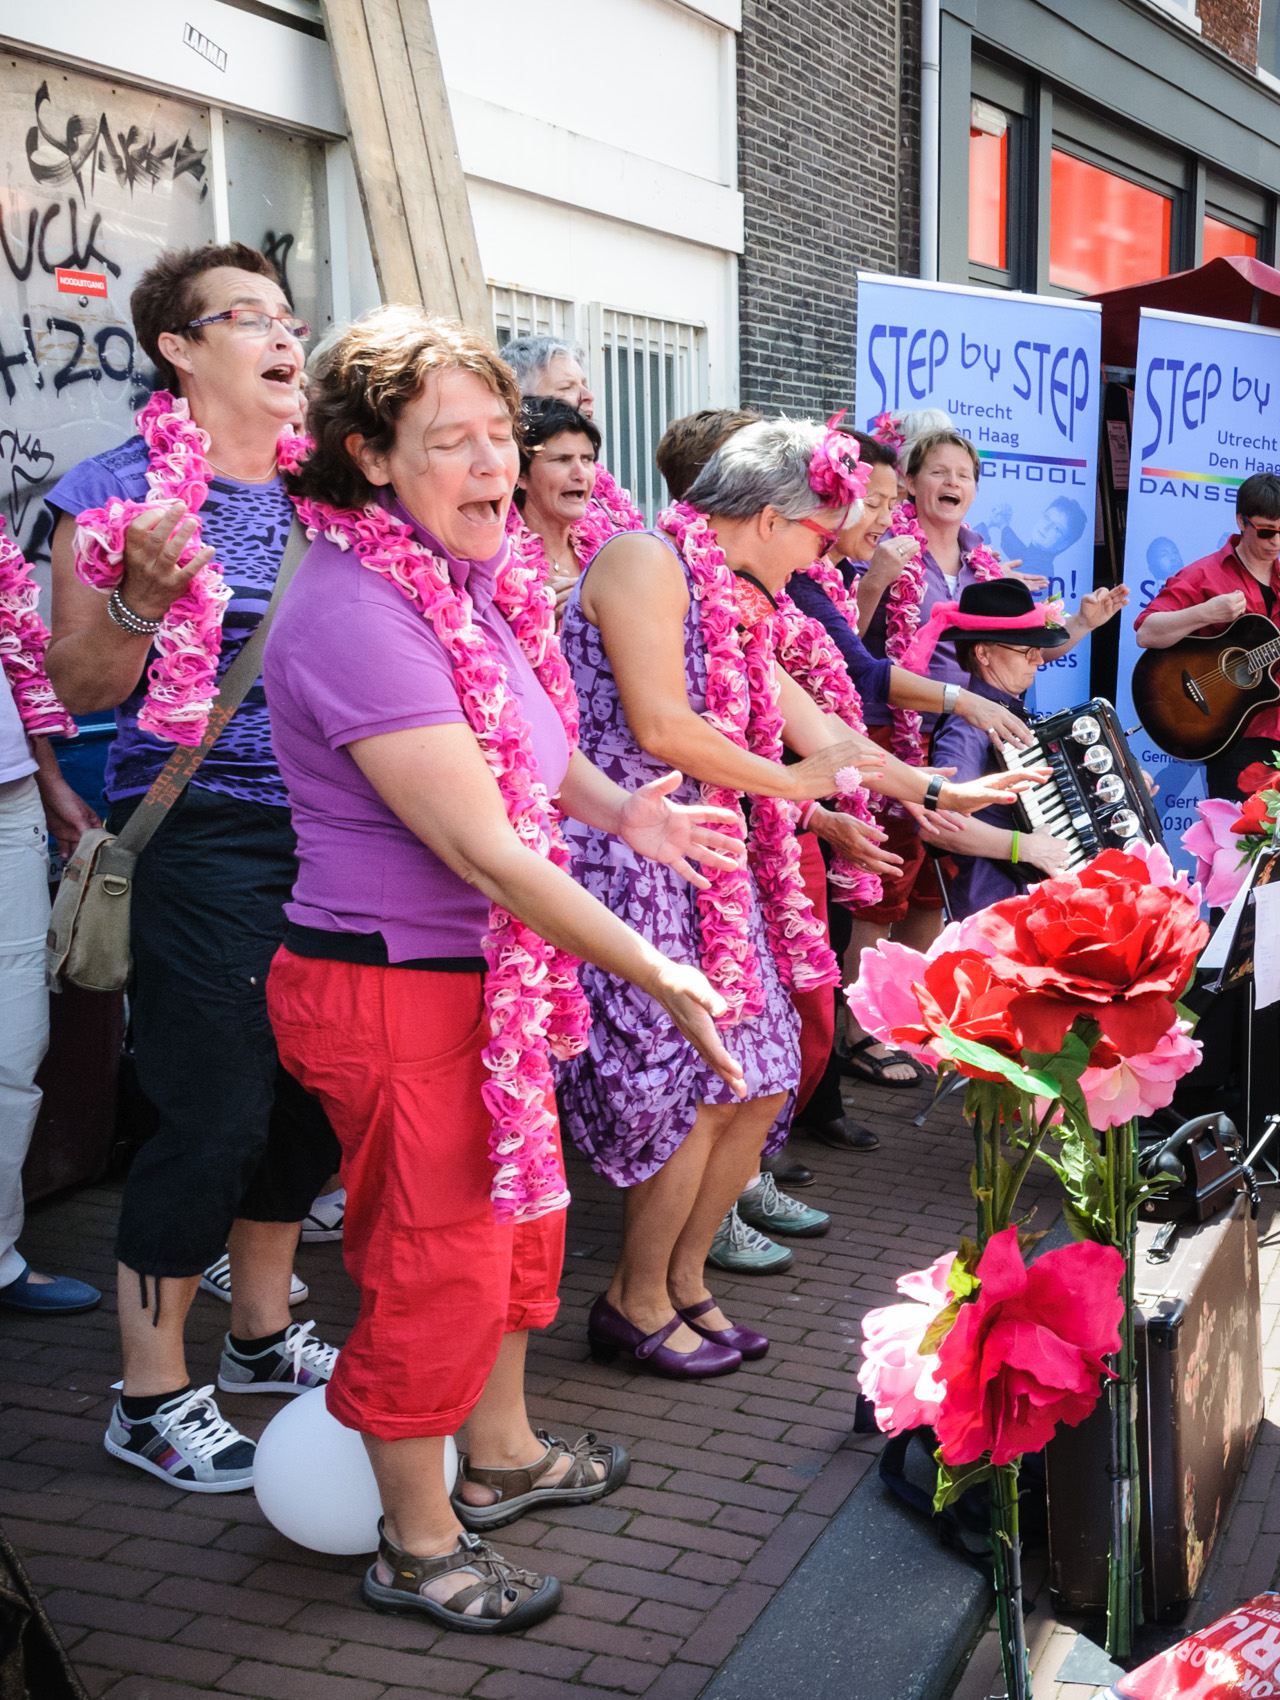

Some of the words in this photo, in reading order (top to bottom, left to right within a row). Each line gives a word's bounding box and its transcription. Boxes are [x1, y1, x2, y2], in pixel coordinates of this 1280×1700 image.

[60, 276, 104, 290] NOODUITGANG
[867, 324, 949, 434] STEP
[961, 332, 1001, 383] by
[1013, 340, 1089, 443] STEP
[948, 399, 1013, 420] Utrecht
[1141, 357, 1222, 462] STEP
[1232, 366, 1270, 415] by
[979, 427, 1019, 448] Haag
[1217, 430, 1278, 452] Utrecht
[1209, 453, 1239, 469] Den
[980, 461, 1086, 486] CHOOL
